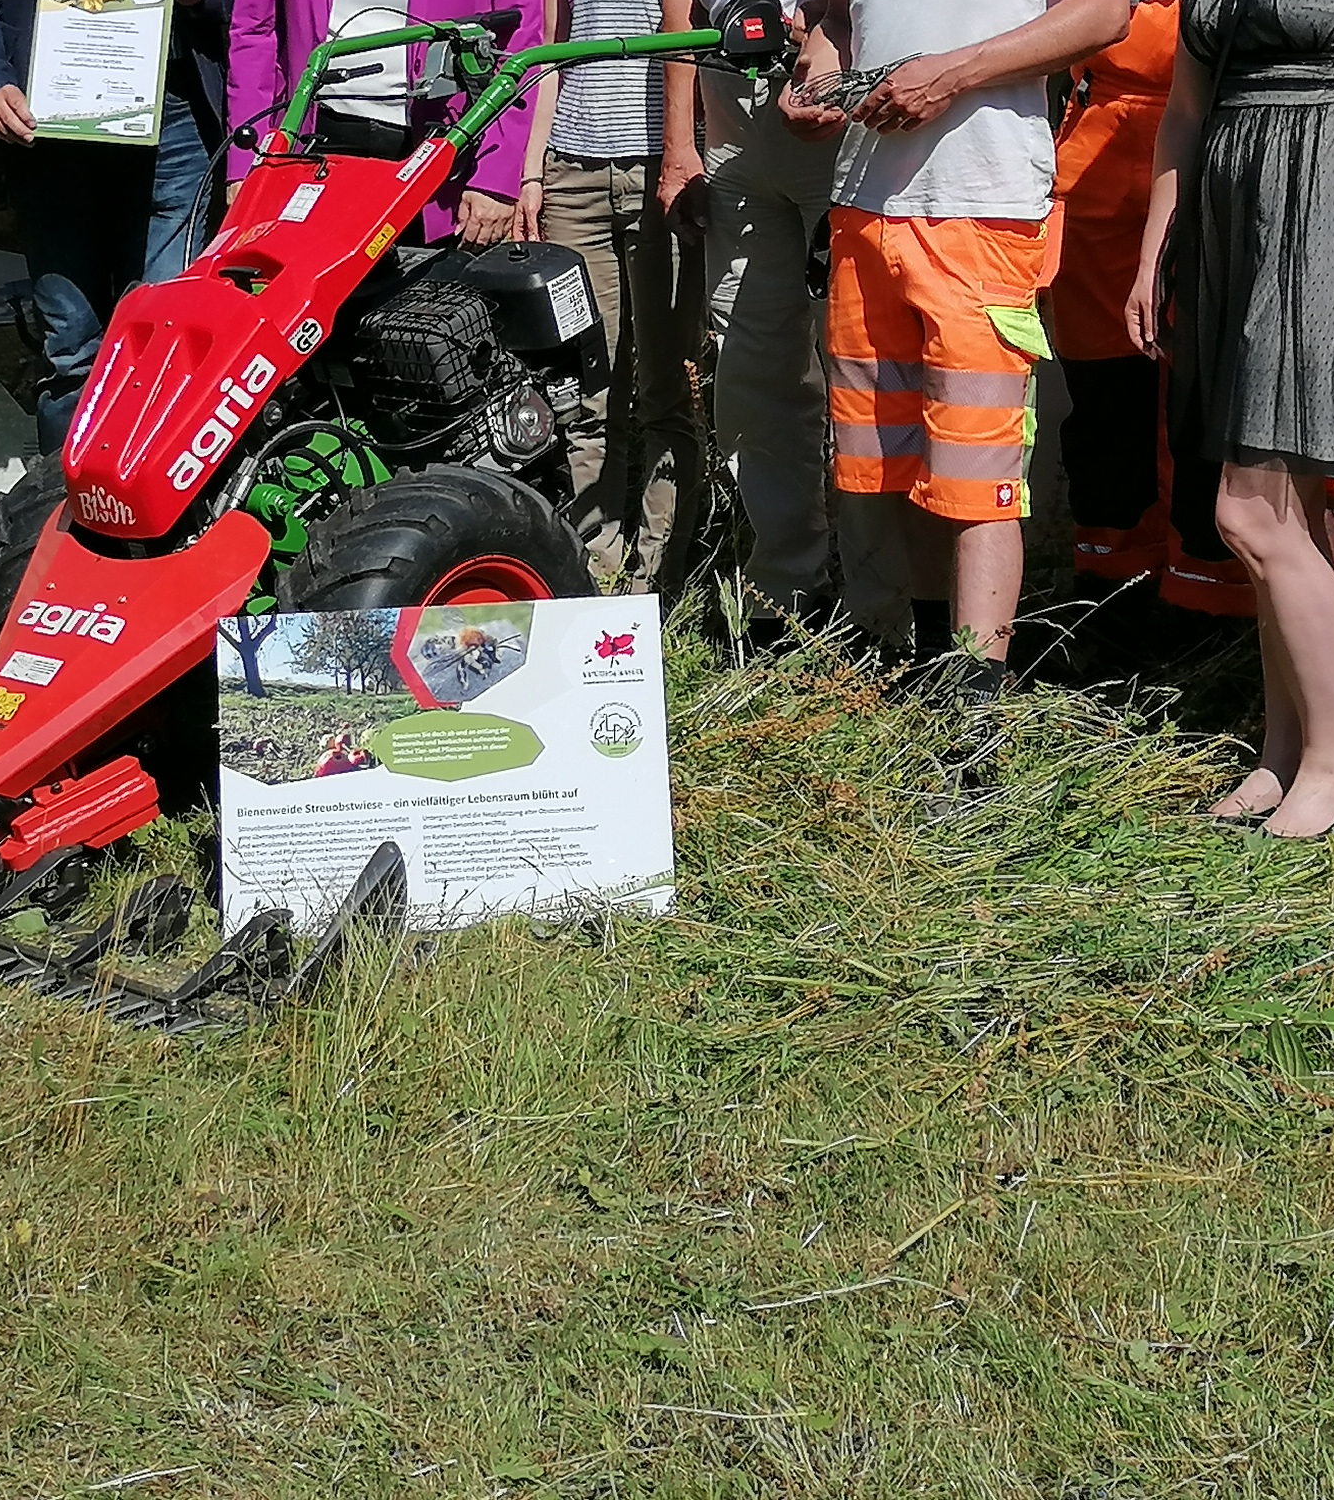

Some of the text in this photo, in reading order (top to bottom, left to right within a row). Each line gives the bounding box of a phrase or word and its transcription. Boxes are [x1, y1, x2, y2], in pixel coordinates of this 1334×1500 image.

[296, 320, 319, 353] GS
[166, 352, 277, 491] agria
[17, 600, 126, 645] agria
[237, 805, 303, 817] Bienenweide
[304, 800, 383, 813] Streuobstwiese
[393, 799, 409, 808] ein
[410, 795, 467, 809] vielfältiger
[467, 792, 531, 804] Lebensraum
[532, 790, 559, 800] blüht
[561, 789, 579, 798] auf
